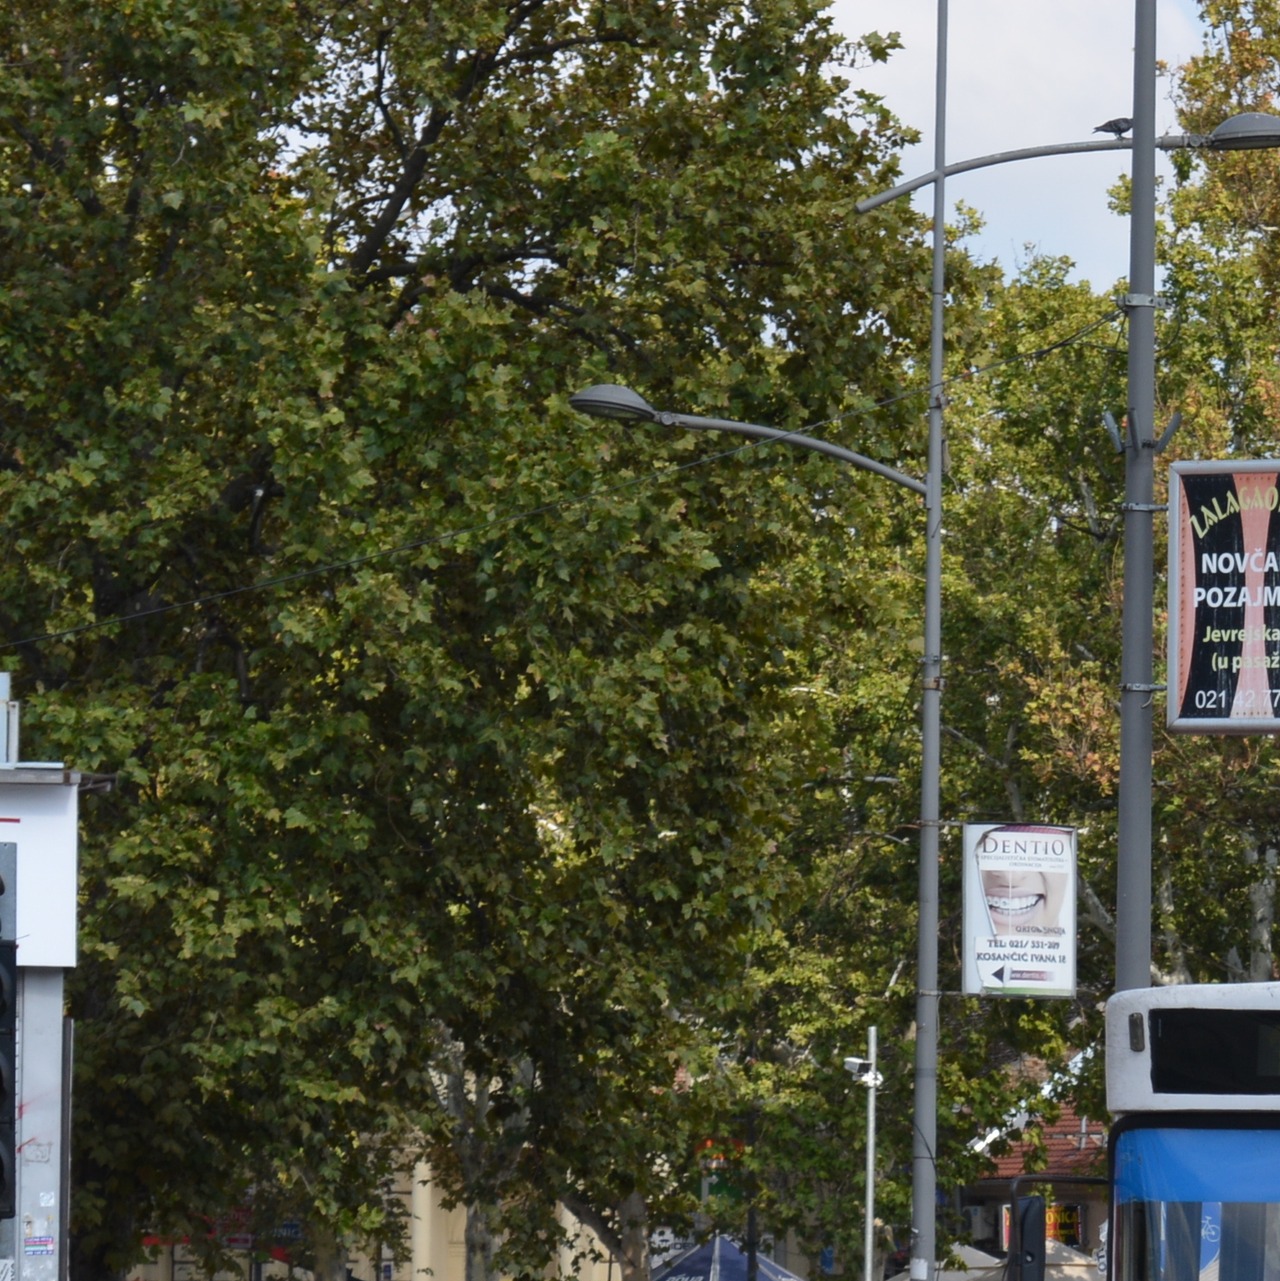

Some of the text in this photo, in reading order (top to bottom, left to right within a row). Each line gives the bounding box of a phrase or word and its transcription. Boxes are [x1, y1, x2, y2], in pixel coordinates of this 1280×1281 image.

[1202, 624, 1280, 645] Jevrejska
[1211, 652, 1229, 673] (u
[1194, 690, 1227, 709] 021
[1234, 690, 1256, 708] 42
[1261, 690, 1280, 708] 77
[1030, 954, 1057, 963] IVANA
